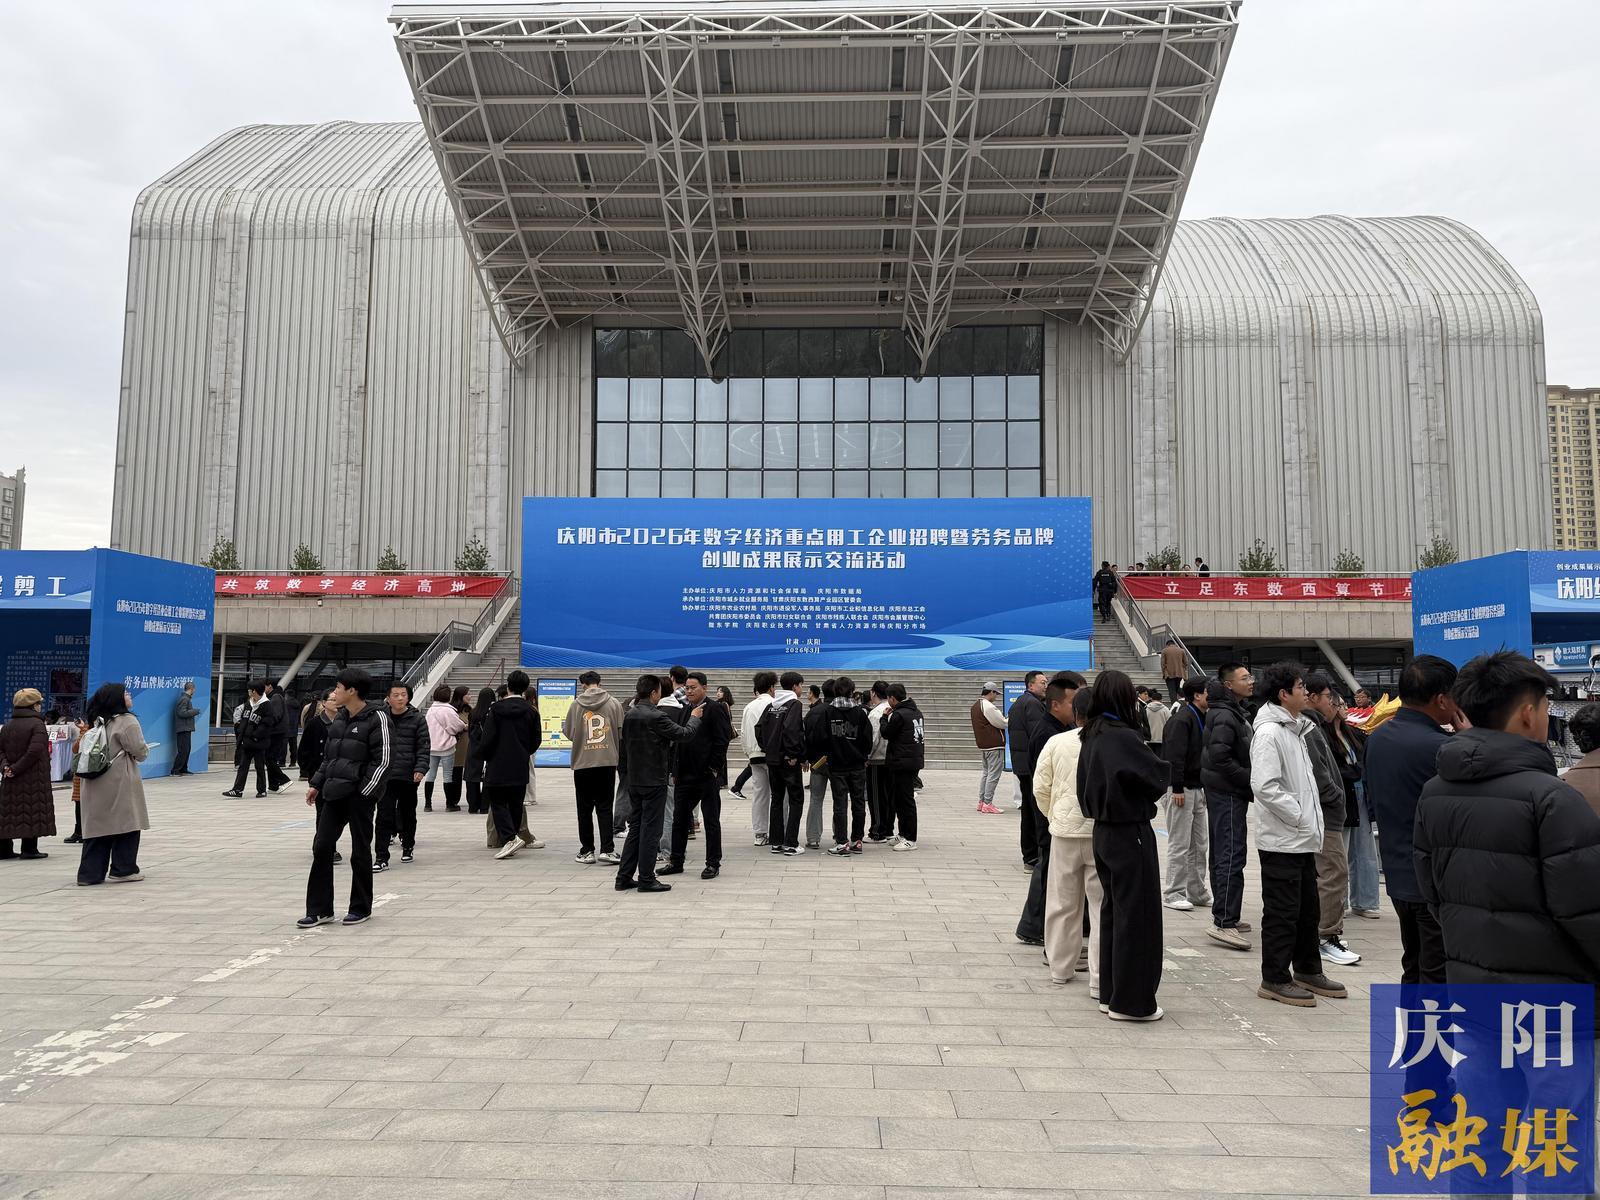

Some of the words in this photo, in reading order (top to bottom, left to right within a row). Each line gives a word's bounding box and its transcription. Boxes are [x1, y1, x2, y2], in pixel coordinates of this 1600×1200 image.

[557, 527, 1054, 546] 庆阳市2026年数字经济重点用工企业招聘暨劳务品牌
[702, 550, 906, 569] 创业成果展示交流活动
[0, 575, 66, 596] 剪工
[222, 578, 466, 593] 共筑数字经济高地
